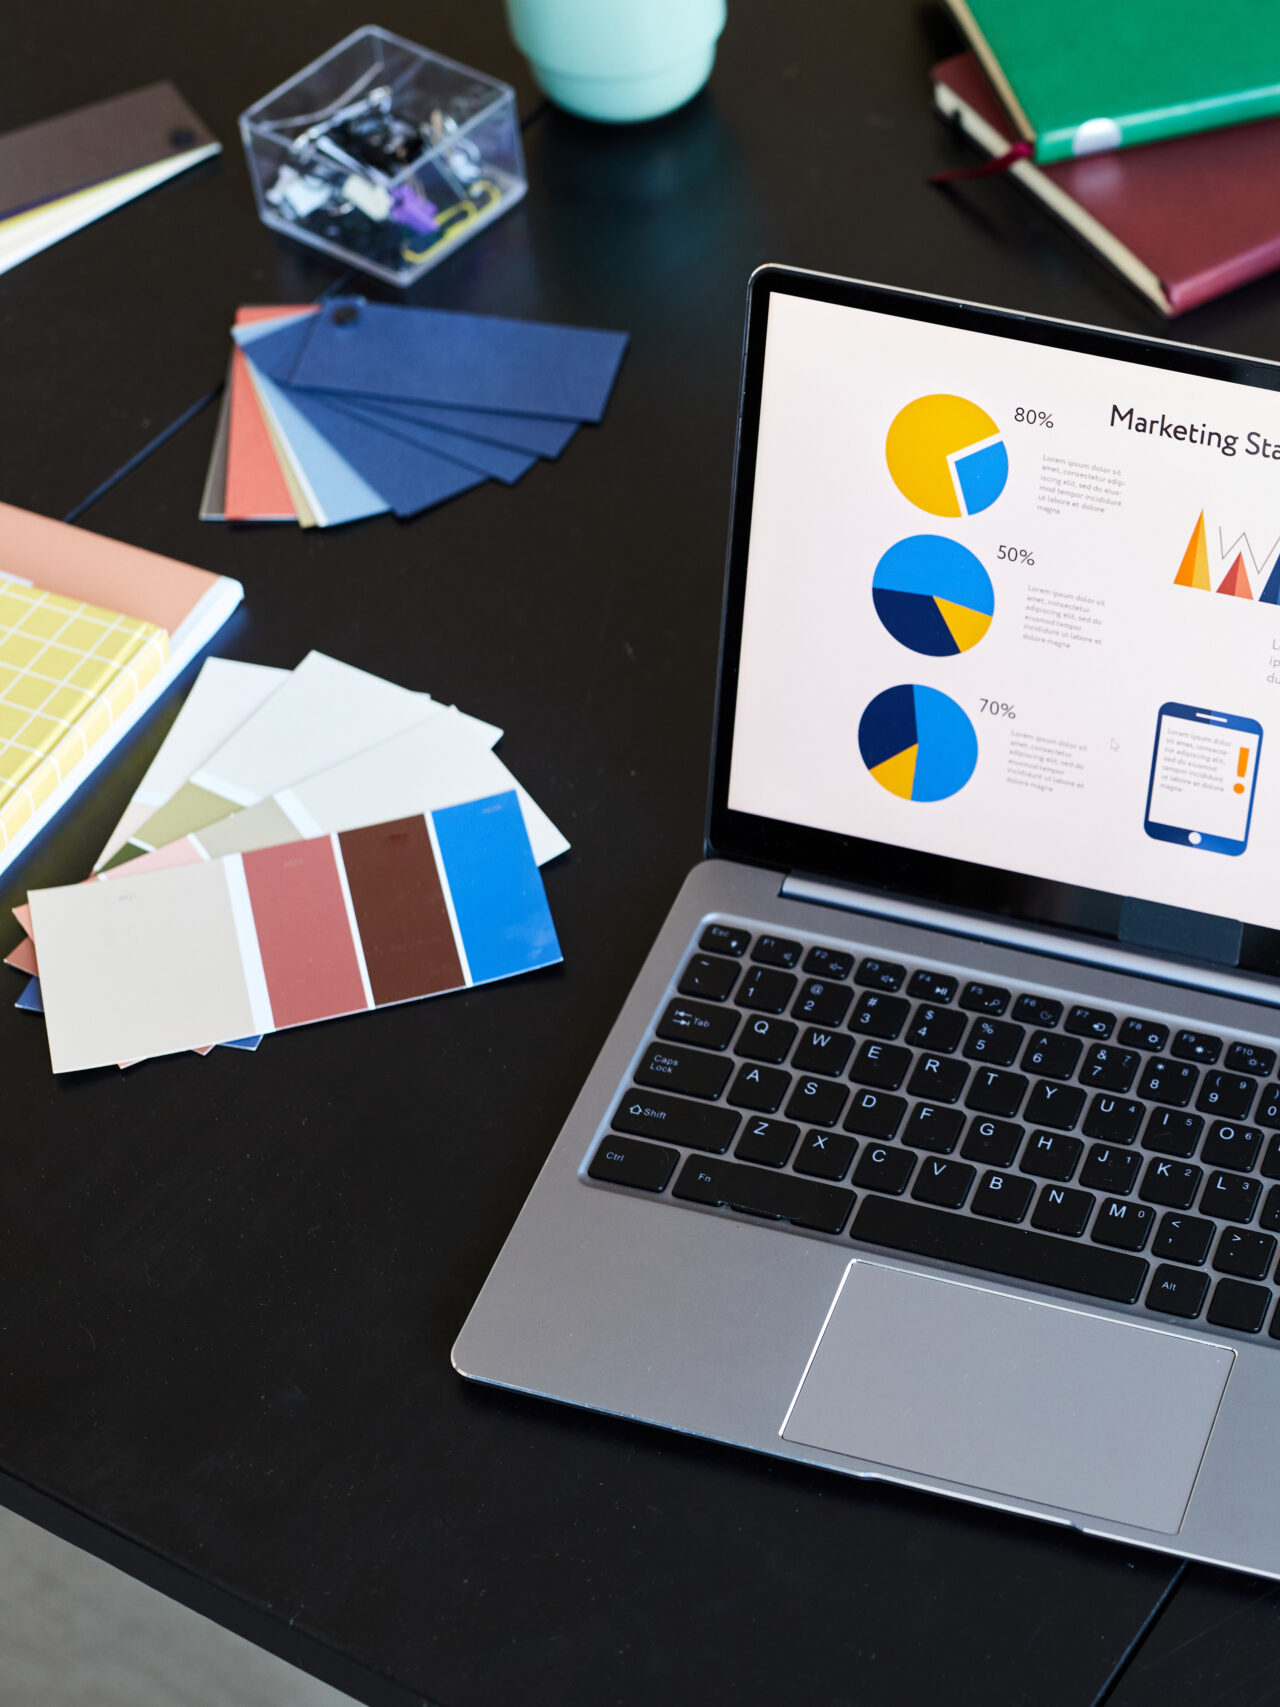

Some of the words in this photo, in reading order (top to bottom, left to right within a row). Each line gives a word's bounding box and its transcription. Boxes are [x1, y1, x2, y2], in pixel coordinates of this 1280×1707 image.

[1014, 407, 1054, 429] 80%
[1110, 404, 1239, 457] Marketing
[997, 545, 1035, 566] 50%
[980, 698, 1016, 719] 70%
[711, 927, 729, 937] Esc
[762, 938, 775, 947] F1
[815, 949, 828, 959] F2
[866, 961, 880, 971] F3
[755, 971, 762, 981] !
[918, 973, 931, 983] F4
[748, 987, 755, 997] 1
[810, 984, 824, 995] @
[970, 985, 984, 995] F5
[803, 1000, 815, 1011] 2
[867, 997, 878, 1007] #
[1023, 998, 1036, 1007] F6
[860, 1013, 871, 1024] 3
[925, 1010, 935, 1020] $
[1076, 1009, 1090, 1018] F7
[694, 1017, 710, 1028] Tab
[754, 1020, 769, 1035] Q
[981, 1022, 994, 1034] %
[1129, 1021, 1142, 1031] F8
[917, 1026, 927, 1036] 4
[812, 1032, 832, 1047] W
[1182, 1033, 1196, 1043] F9
[975, 1039, 986, 1050] 5
[867, 1045, 882, 1059] E
[1096, 1049, 1107, 1060] &
[1235, 1045, 1254, 1056] F10
[654, 1054, 679, 1067] Caps
[1032, 1052, 1043, 1063] 6
[650, 1062, 673, 1074] Lock
[925, 1058, 940, 1073] R
[1092, 1065, 1103, 1076] 7
[746, 1069, 759, 1082] A
[1181, 1068, 1189, 1076] 8
[987, 1072, 999, 1085] T
[1149, 1078, 1160, 1089] 8
[1215, 1076, 1222, 1087] (
[804, 1082, 818, 1095] S
[1239, 1081, 1247, 1089] 9
[1045, 1086, 1058, 1099] Y
[1208, 1092, 1219, 1103] 9
[1274, 1089, 1280, 1099] )
[861, 1094, 877, 1108] D
[1100, 1099, 1115, 1113] U
[643, 1107, 667, 1120] Shift
[919, 1107, 934, 1120] F
[1267, 1105, 1277, 1116] 0
[1162, 1113, 1169, 1125] I
[1185, 1118, 1193, 1126] 5
[753, 1121, 769, 1136] Z
[979, 1122, 995, 1136] G
[1219, 1127, 1235, 1140] O
[1244, 1132, 1252, 1140] 6
[812, 1135, 828, 1149] X
[1037, 1136, 1053, 1150] H
[606, 1151, 625, 1162] Ctrl
[872, 1149, 887, 1163] C
[1097, 1150, 1110, 1162] J
[1127, 1156, 1131, 1164] 1
[933, 1162, 947, 1176] V
[1157, 1162, 1172, 1177] K
[1184, 1168, 1192, 1177] 2
[697, 1173, 711, 1183] Fn
[989, 1176, 1003, 1190] B
[1216, 1176, 1227, 1190] L
[1242, 1182, 1250, 1190] 3
[1048, 1189, 1065, 1204] N
[1109, 1203, 1127, 1218] M
[1137, 1210, 1145, 1219] 0
[1161, 1281, 1177, 1291] Alt
